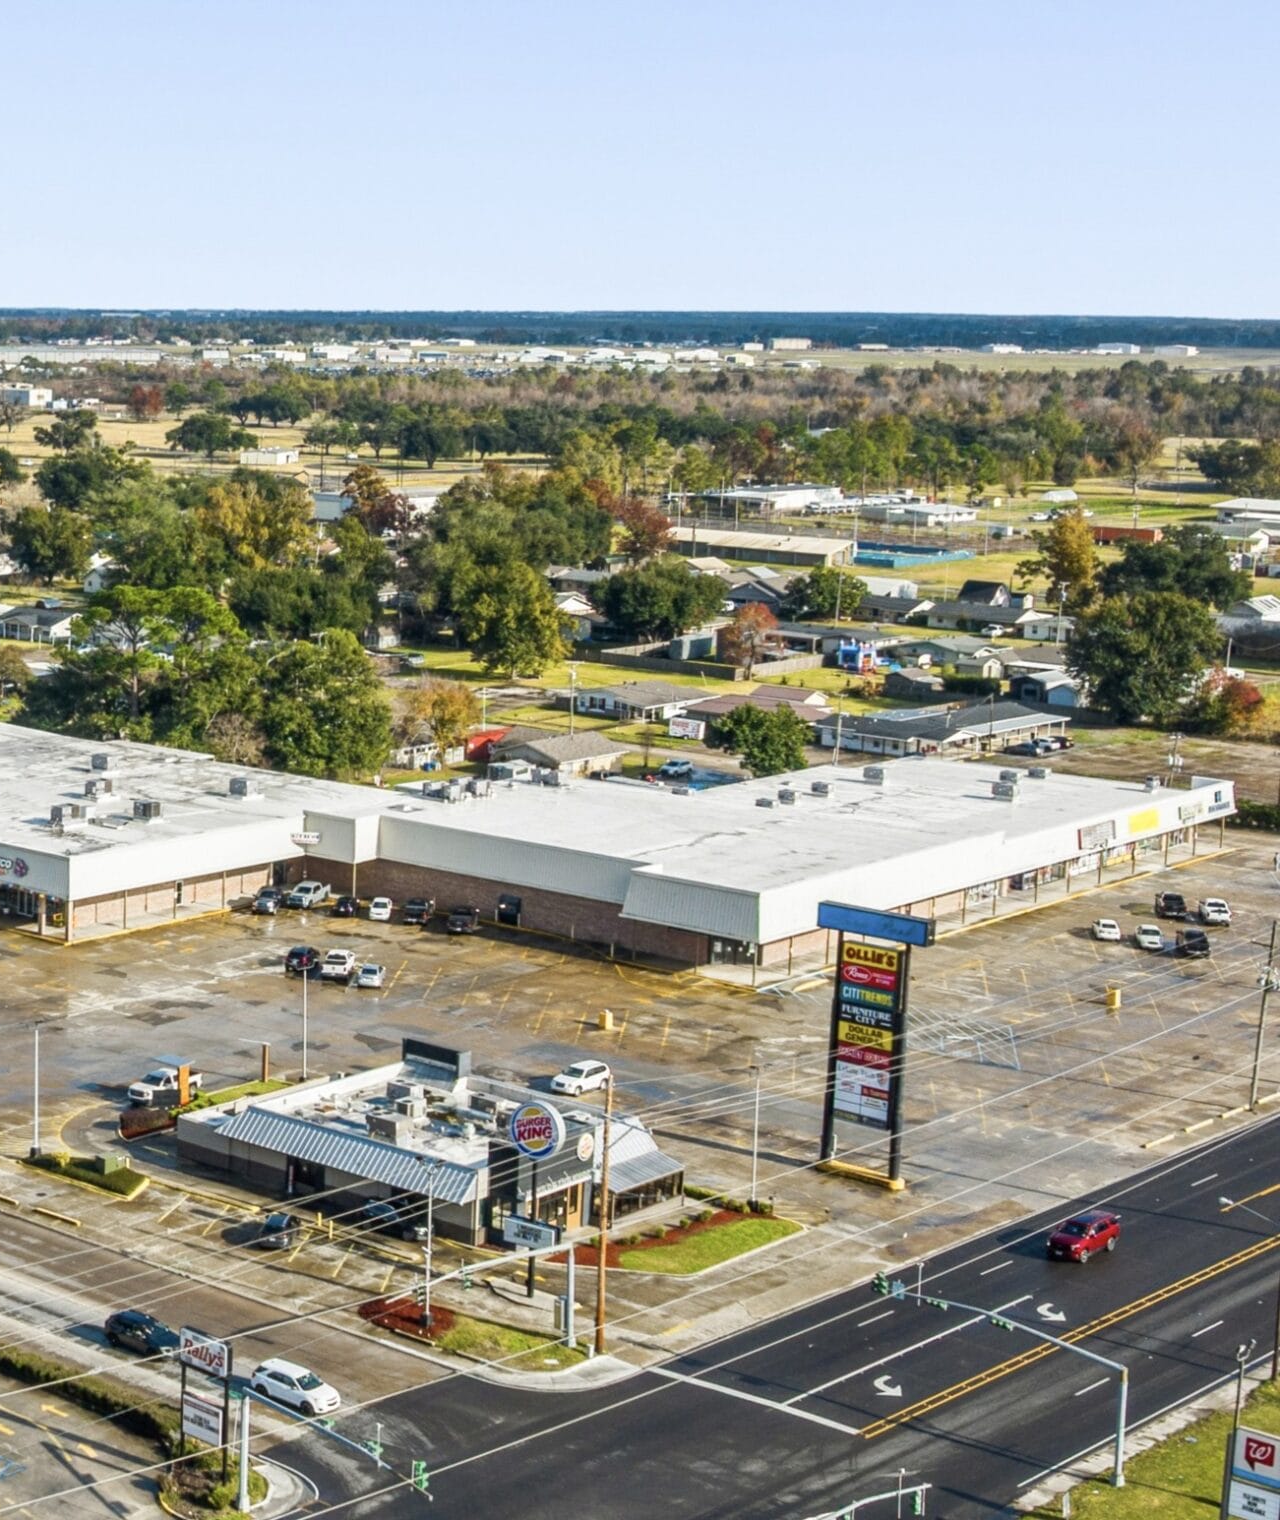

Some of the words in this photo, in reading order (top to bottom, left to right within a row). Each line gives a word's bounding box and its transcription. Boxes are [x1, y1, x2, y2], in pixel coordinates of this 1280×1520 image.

[846, 946, 896, 968] OLLIE'S
[841, 1003, 892, 1022] FURNITURE
[855, 1014, 877, 1026] CITY
[848, 1024, 883, 1039] DOLLAR
[516, 1116, 551, 1128] BURGER
[517, 1126, 553, 1142] KING
[184, 1337, 225, 1368] Rally's
